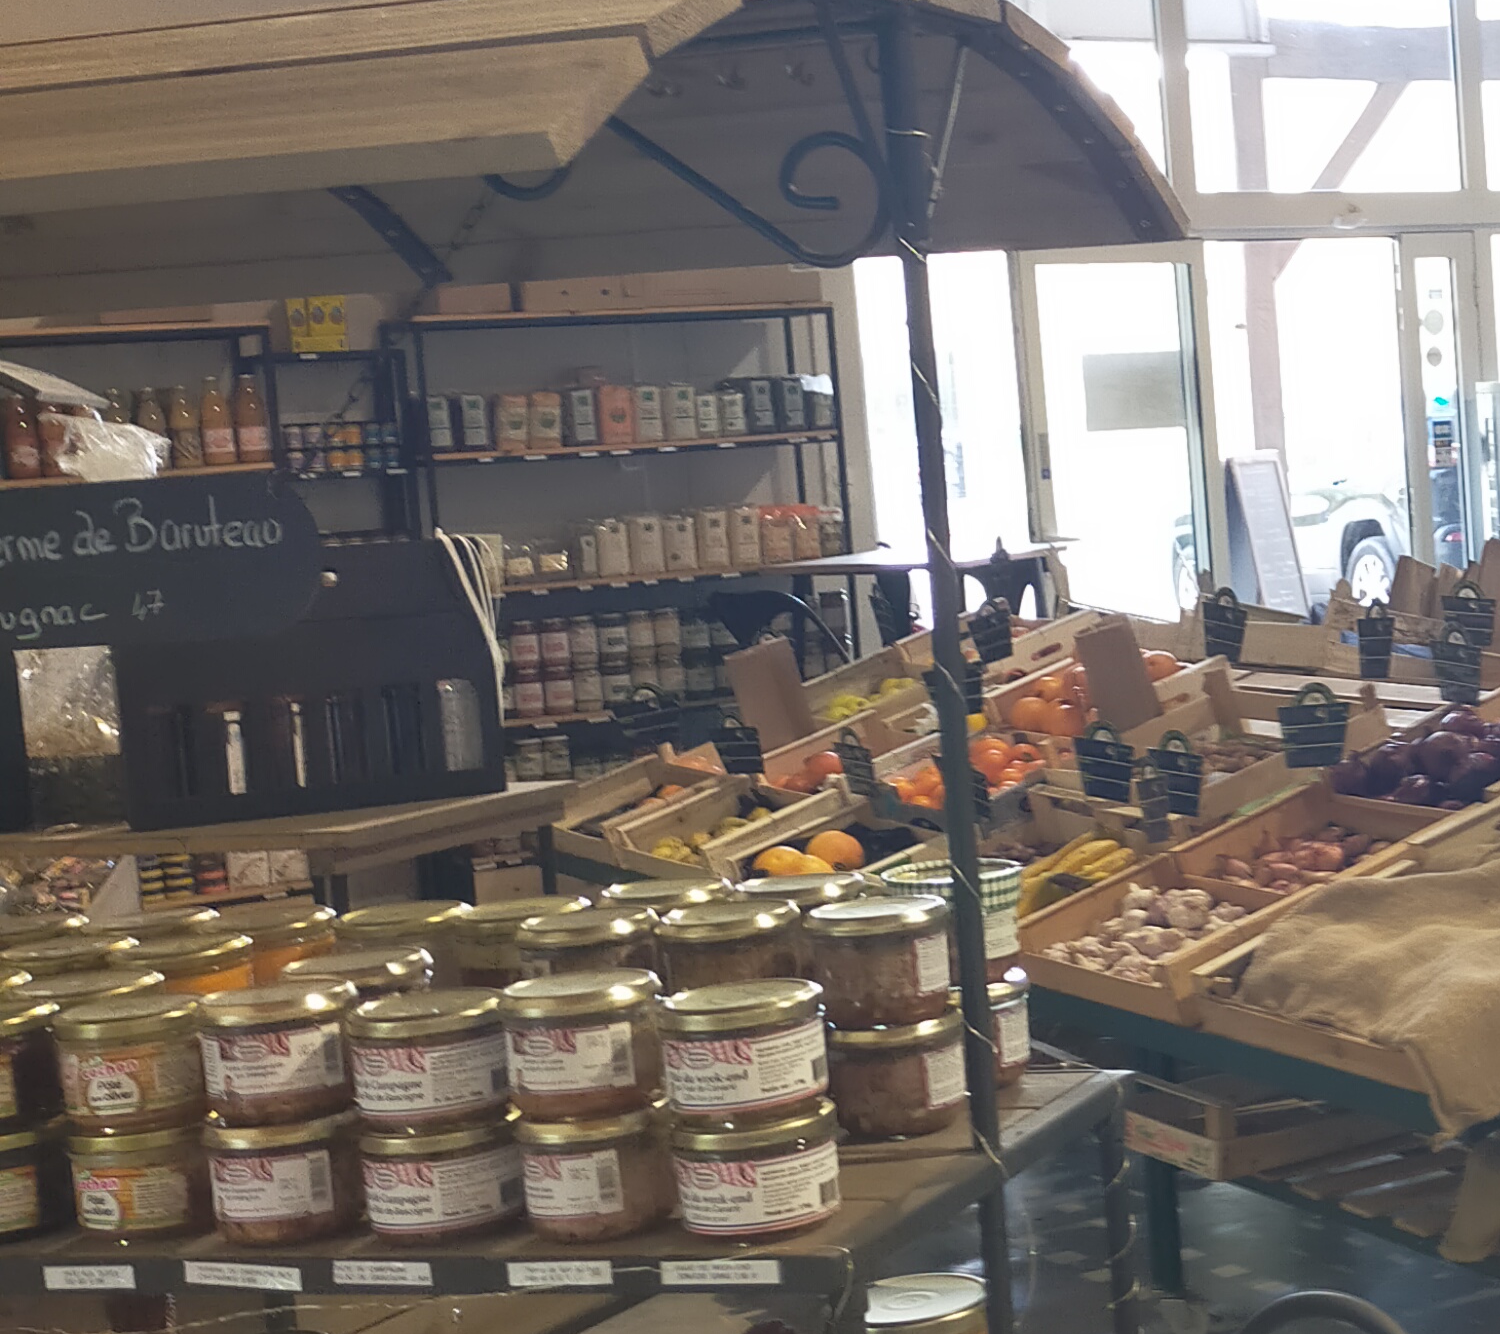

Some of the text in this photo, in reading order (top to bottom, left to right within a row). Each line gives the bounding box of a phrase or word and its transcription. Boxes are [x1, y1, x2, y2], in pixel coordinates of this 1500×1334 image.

[72, 510, 117, 556] de
[113, 495, 283, 553] Baruteau
[131, 589, 165, 621] 47
